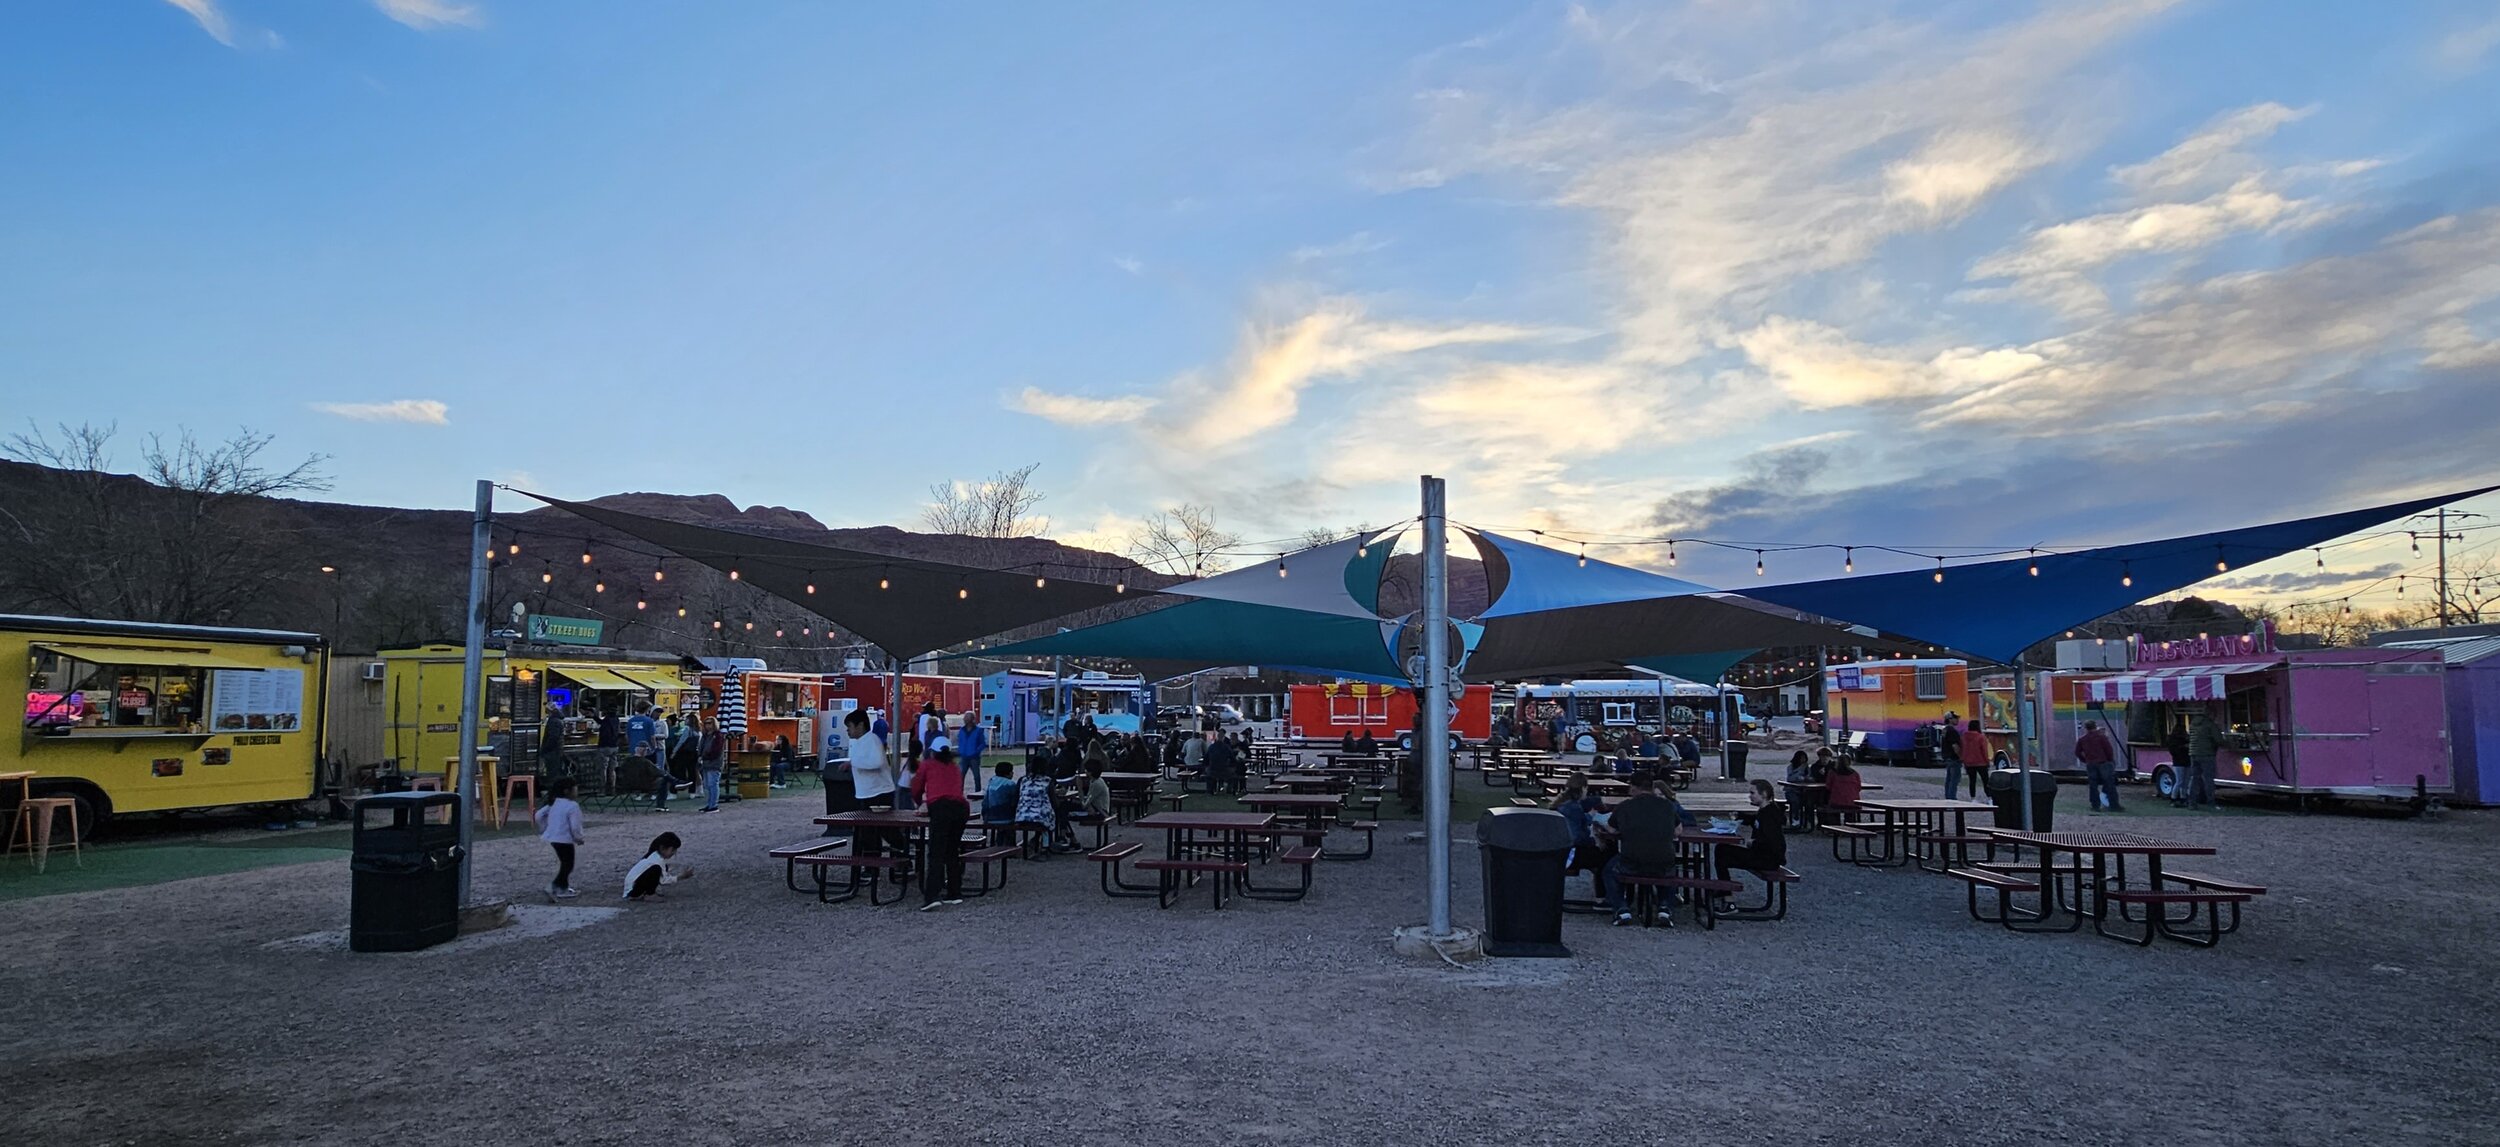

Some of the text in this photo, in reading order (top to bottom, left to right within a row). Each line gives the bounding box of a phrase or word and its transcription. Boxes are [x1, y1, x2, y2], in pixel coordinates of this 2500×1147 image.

[548, 624, 577, 636] STREET
[2142, 634, 2255, 662] MISS GELATO
